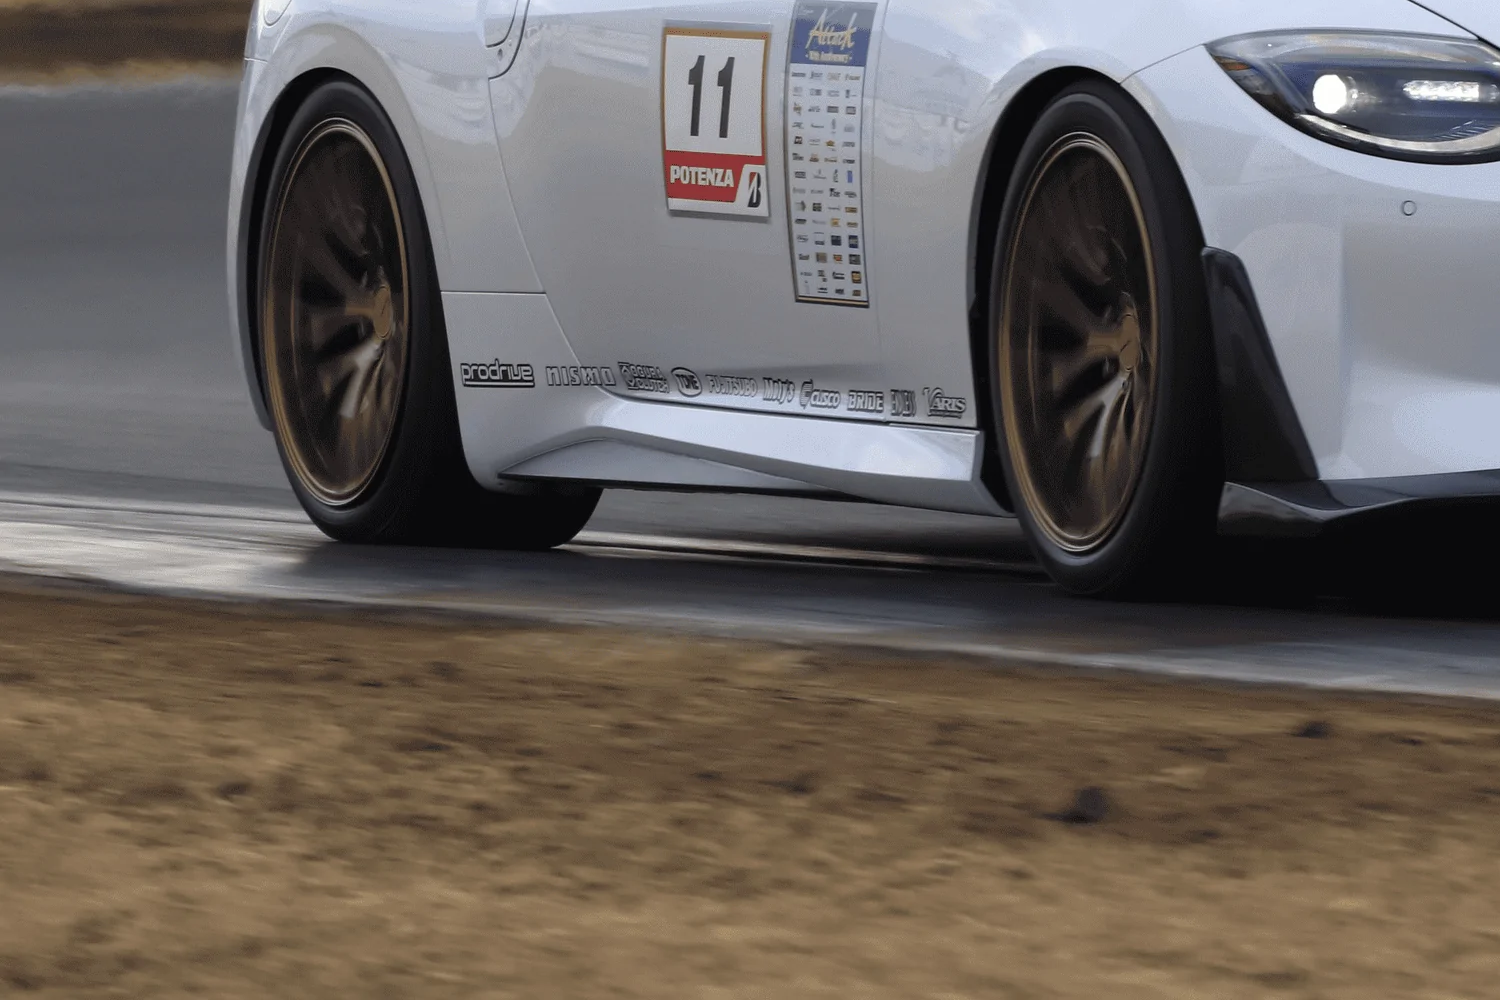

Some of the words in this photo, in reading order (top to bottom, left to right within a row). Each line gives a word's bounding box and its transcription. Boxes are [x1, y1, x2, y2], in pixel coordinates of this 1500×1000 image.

[688, 55, 735, 138] 11
[670, 165, 734, 188] POTENZA
[461, 359, 535, 383] prodrive
[848, 390, 885, 412] BRIDE
